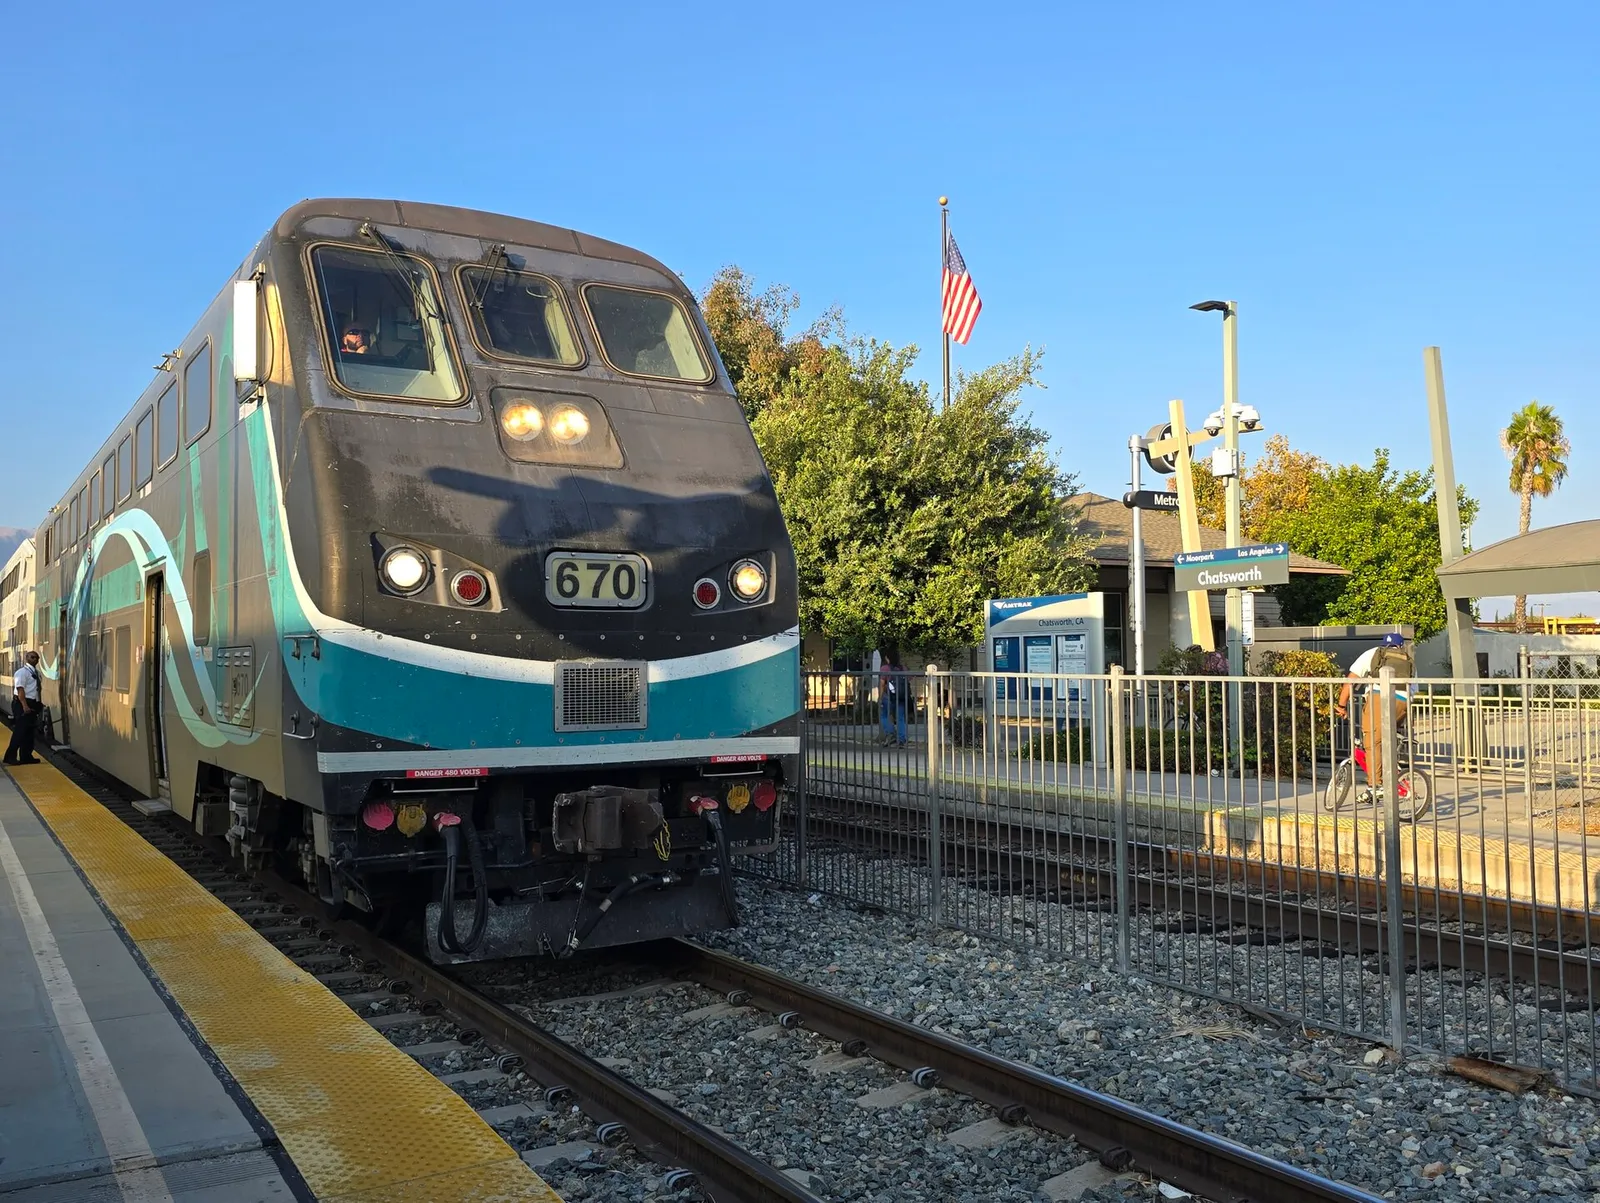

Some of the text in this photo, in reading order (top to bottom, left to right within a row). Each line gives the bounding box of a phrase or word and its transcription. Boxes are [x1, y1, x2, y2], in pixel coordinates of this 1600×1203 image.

[1186, 552, 1214, 563] Moorpark
[1238, 546, 1274, 558] Los Angeles
[556, 561, 635, 600] 670
[1198, 565, 1262, 585] Chatsworth
[1038, 618, 1074, 627] Chatsworth,
[459, 768, 481, 776] VOLTS
